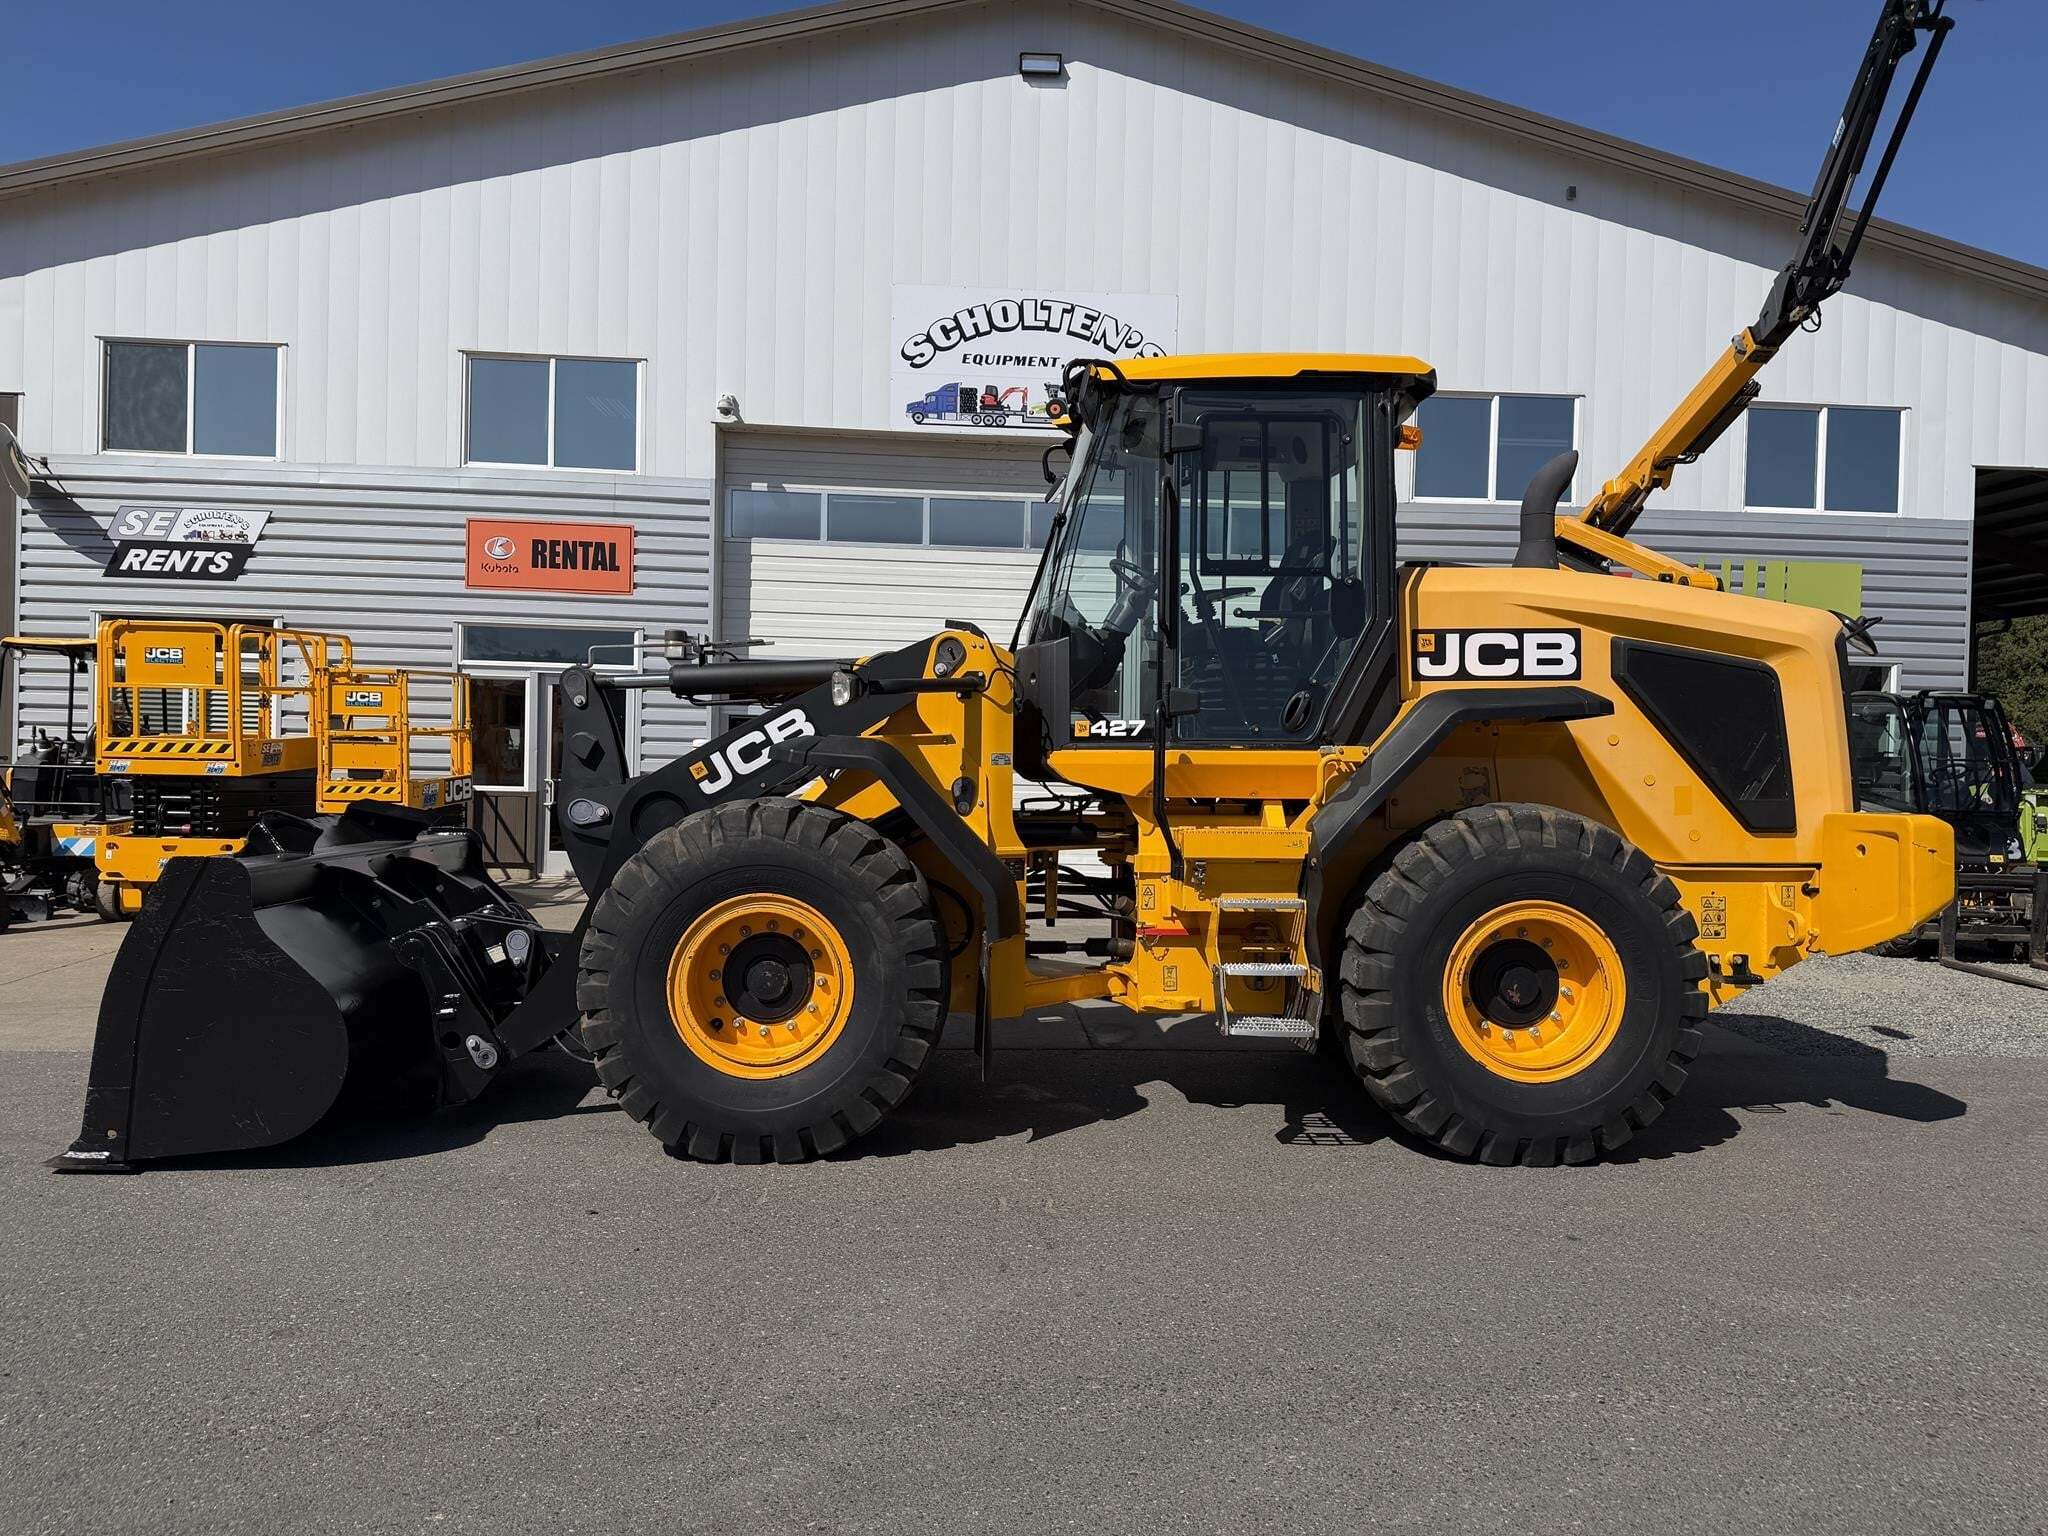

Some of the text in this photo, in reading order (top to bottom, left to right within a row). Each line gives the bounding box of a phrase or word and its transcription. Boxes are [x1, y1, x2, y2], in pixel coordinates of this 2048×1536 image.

[961, 353, 1066, 369] EQUIPMENT,
[118, 510, 176, 536] SE
[119, 548, 233, 574] RENTS
[531, 538, 620, 572] RENTAL
[481, 563, 519, 573] Kubota
[146, 648, 183, 659] JCB
[1417, 632, 1578, 677] JCB
[346, 691, 382, 702] JCB
[1090, 719, 1146, 737] 427
[698, 708, 816, 795] JCB
[445, 778, 472, 803] JCB
